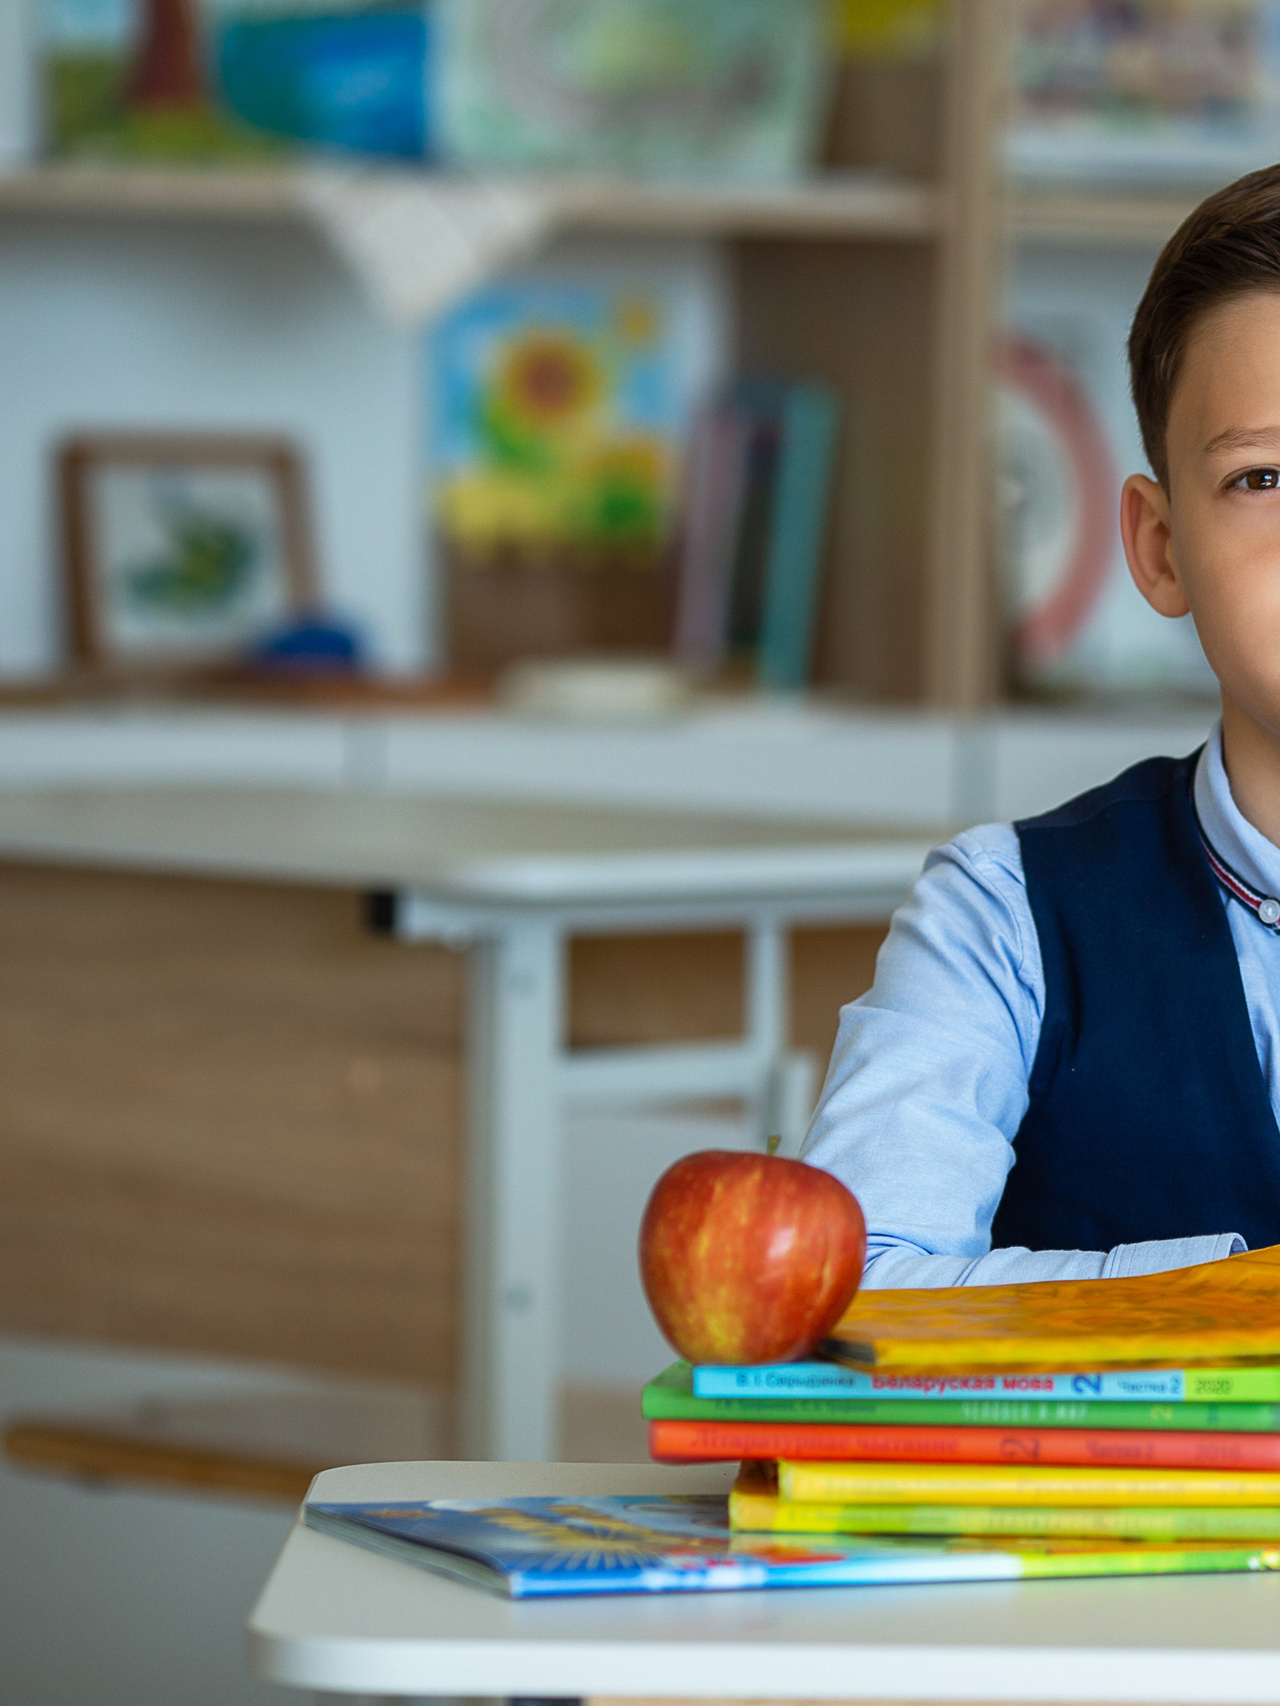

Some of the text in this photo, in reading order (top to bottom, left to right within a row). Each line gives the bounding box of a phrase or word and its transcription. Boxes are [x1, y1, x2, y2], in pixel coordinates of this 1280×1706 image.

[872, 1376, 995, 1395] Беларуская
[1002, 1379, 1055, 1392] мова
[1072, 1374, 1101, 1395] 2
[999, 1437, 1040, 1460] 2
